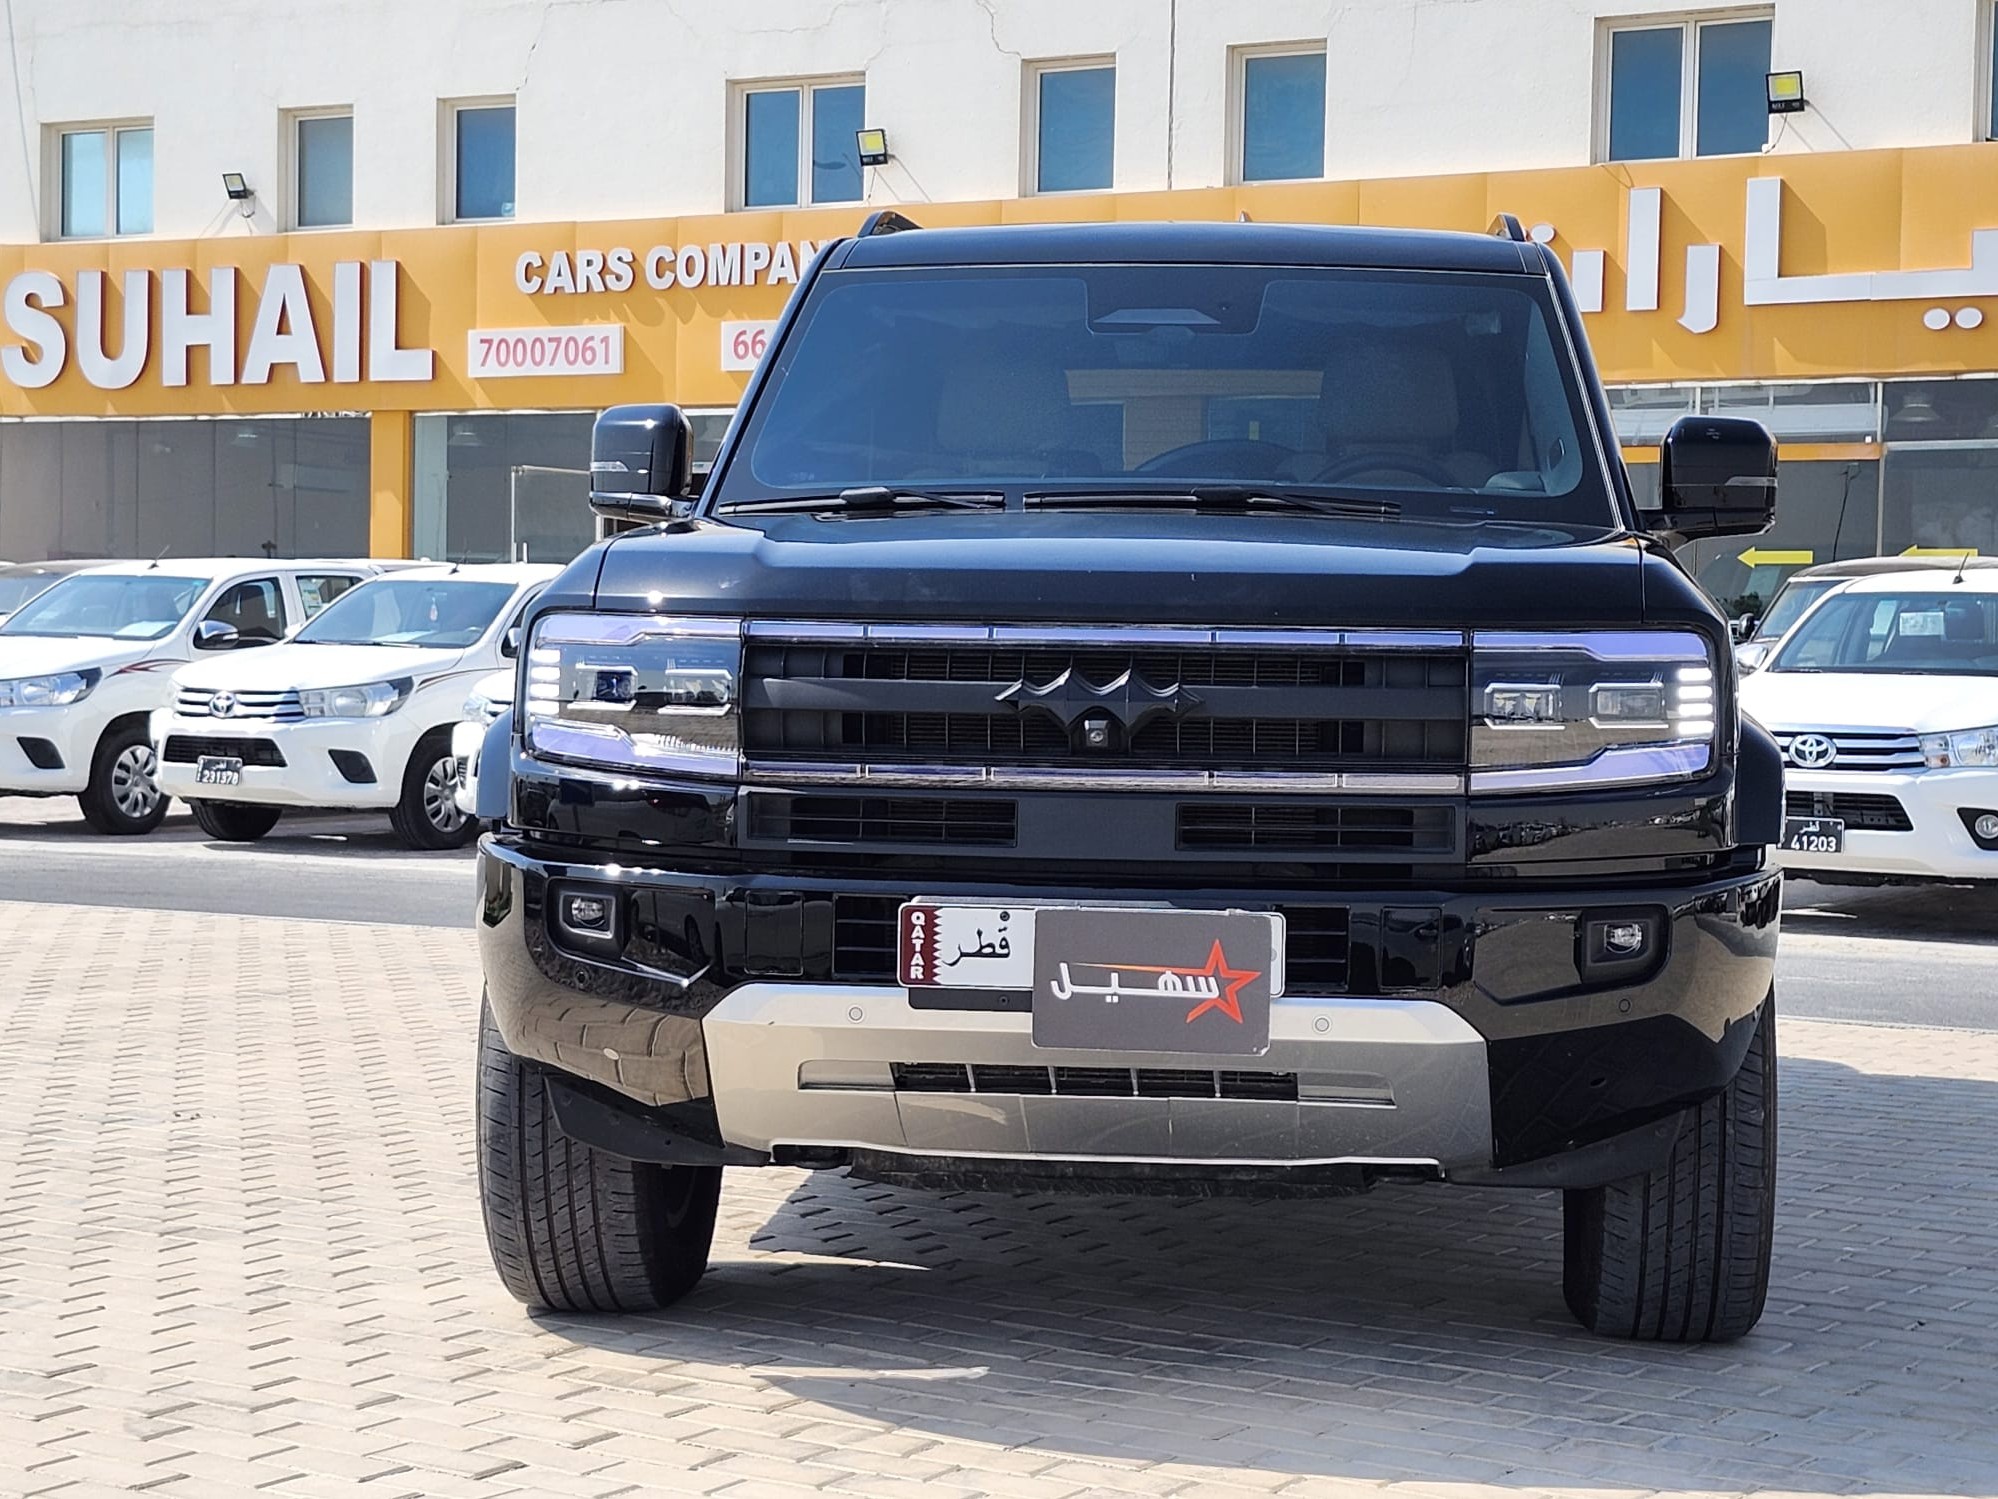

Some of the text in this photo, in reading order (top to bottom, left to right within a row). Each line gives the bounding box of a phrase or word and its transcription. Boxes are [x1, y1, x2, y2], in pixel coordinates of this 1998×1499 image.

[515, 247, 635, 295] CARS
[2, 259, 434, 390] SUHAIL
[479, 335, 611, 368] 70007061
[1791, 834, 1837, 852] 41203
[910, 911, 926, 980] QATAR
[1050, 961, 1220, 1003] سهيل
